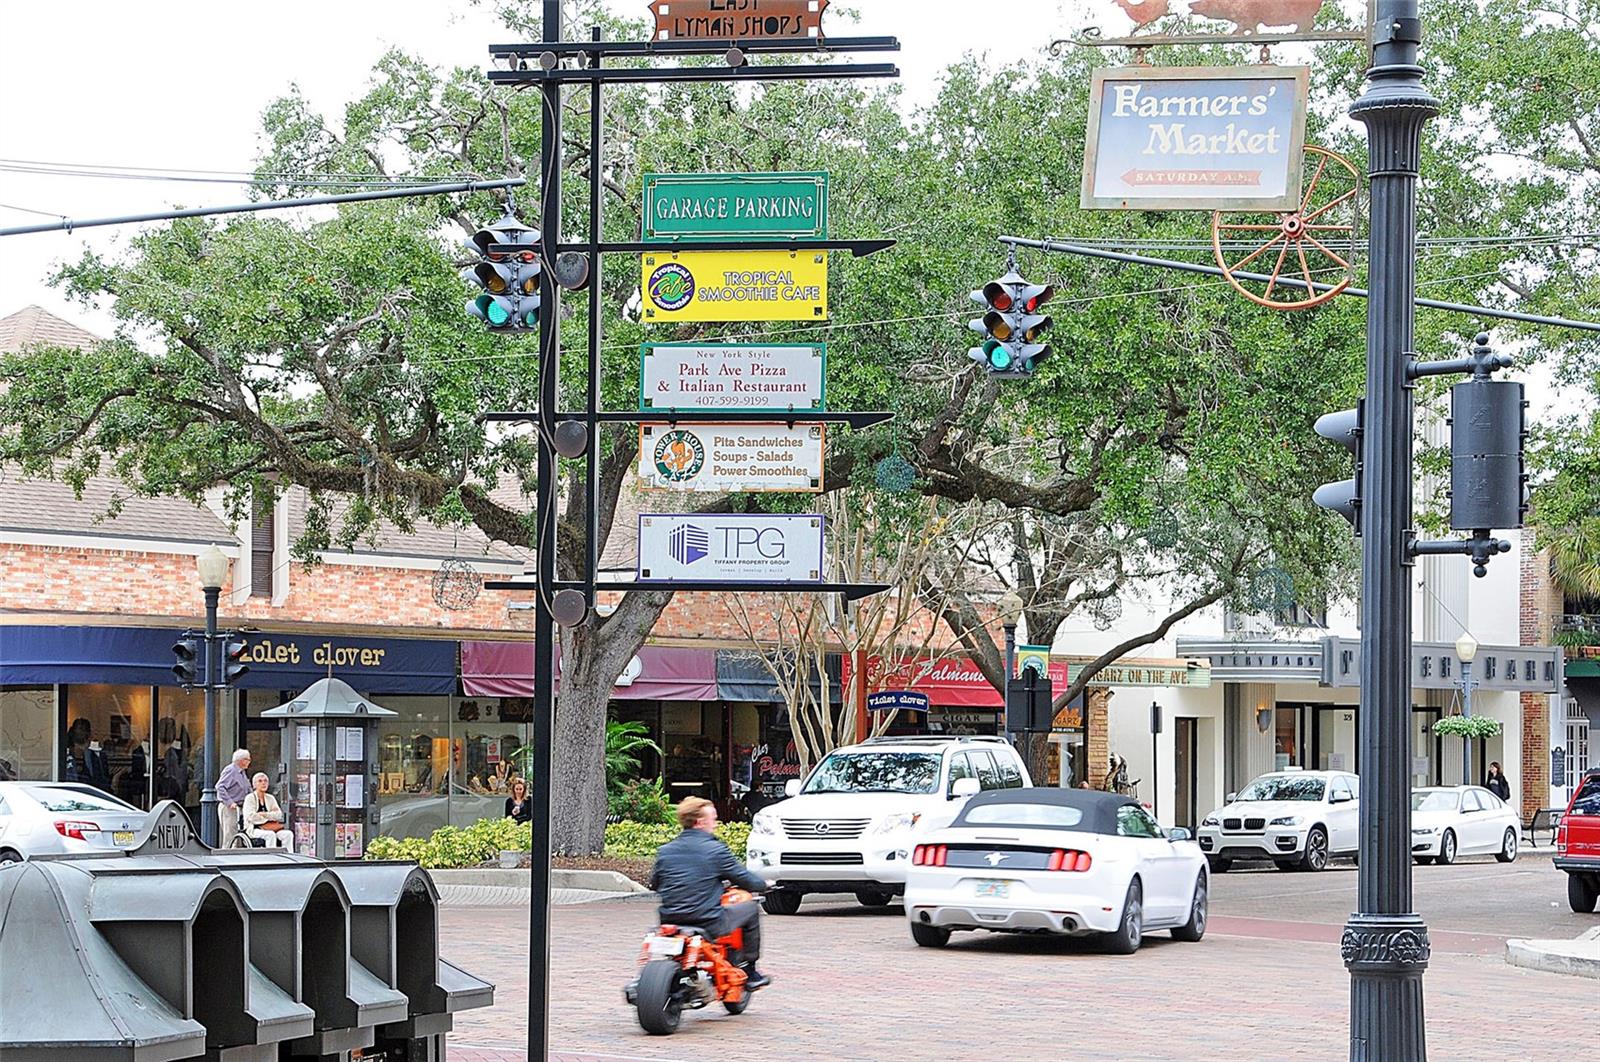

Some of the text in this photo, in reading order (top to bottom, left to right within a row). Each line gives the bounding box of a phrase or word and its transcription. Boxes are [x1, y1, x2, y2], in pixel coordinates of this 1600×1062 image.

[674, 15, 803, 37] LYMAN SHOPS
[1111, 83, 1277, 117] Farmers'
[1141, 122, 1281, 155] Market
[1135, 172, 1218, 182] SATURDAY
[656, 196, 814, 220] GARAGE PARKING
[723, 271, 794, 285] TROPICAL
[698, 286, 820, 301] SMOOTHIE CAFE
[696, 350, 772, 360] New York Style
[679, 363, 787, 376] Park Ave Pizza
[657, 379, 807, 393] & Italian Restaurant
[695, 396, 769, 406] 407-599-9199
[713, 436, 804, 447] Pita Sandwiches
[655, 431, 703, 467] POWER HOUSE
[713, 451, 747, 462] Soups
[757, 450, 793, 462] Salads
[713, 465, 808, 477] Power Smoothies
[714, 527, 785, 559] TPG
[239, 639, 385, 666] iolet clover
[1127, 669, 1142, 682] ON
[1146, 670, 1165, 684] THE
[1169, 671, 1190, 685] AVE.
[942, 714, 981, 722] CIGAR
[158, 825, 187, 850] NEWS
